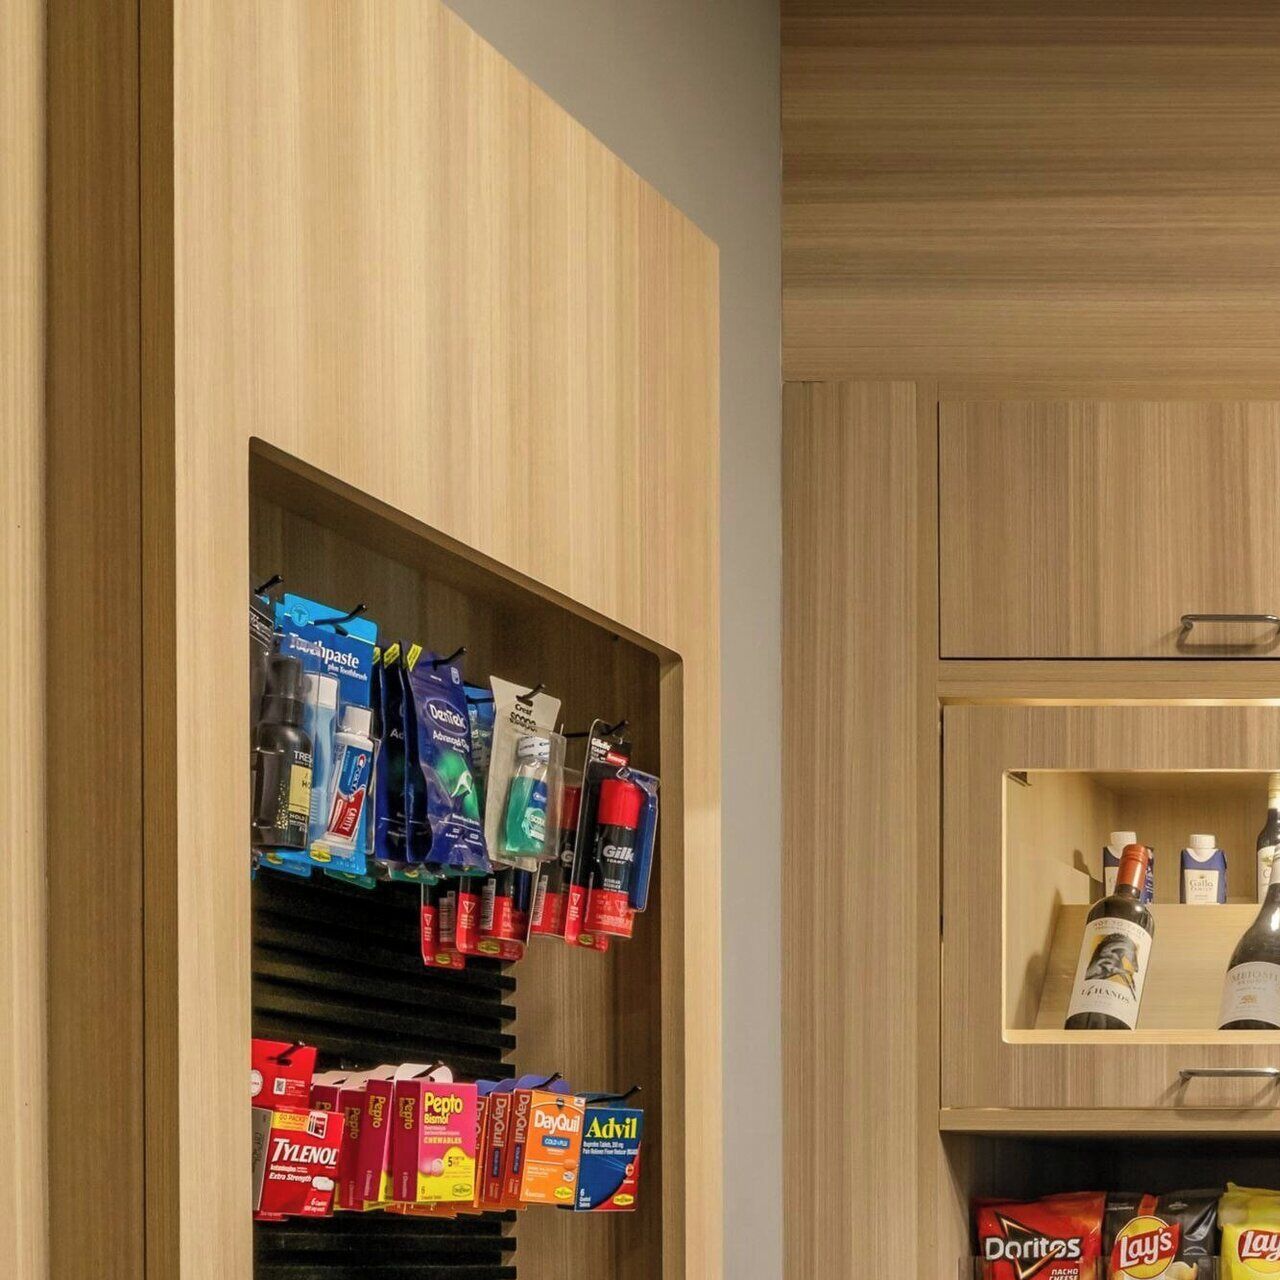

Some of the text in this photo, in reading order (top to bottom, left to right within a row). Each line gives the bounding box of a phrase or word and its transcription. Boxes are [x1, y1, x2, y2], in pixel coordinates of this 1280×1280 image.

[289, 632, 359, 669] Toothpaste
[372, 1096, 386, 1128] Pepto
[405, 1098, 415, 1130] Pepto
[424, 1092, 464, 1116] Pepto
[424, 1113, 450, 1125] Bismol
[493, 1099, 508, 1147] DayQuil
[515, 1094, 530, 1143] DayQuil
[534, 1110, 580, 1133] DayQuil
[585, 1117, 638, 1139] Advil
[271, 1138, 339, 1166] TYLENOL
[269, 1173, 312, 1183] Extra Strength
[985, 1236, 1082, 1261] Doritos
[1120, 1228, 1173, 1269] Lay's
[1051, 1268, 1079, 1276] NACHO
